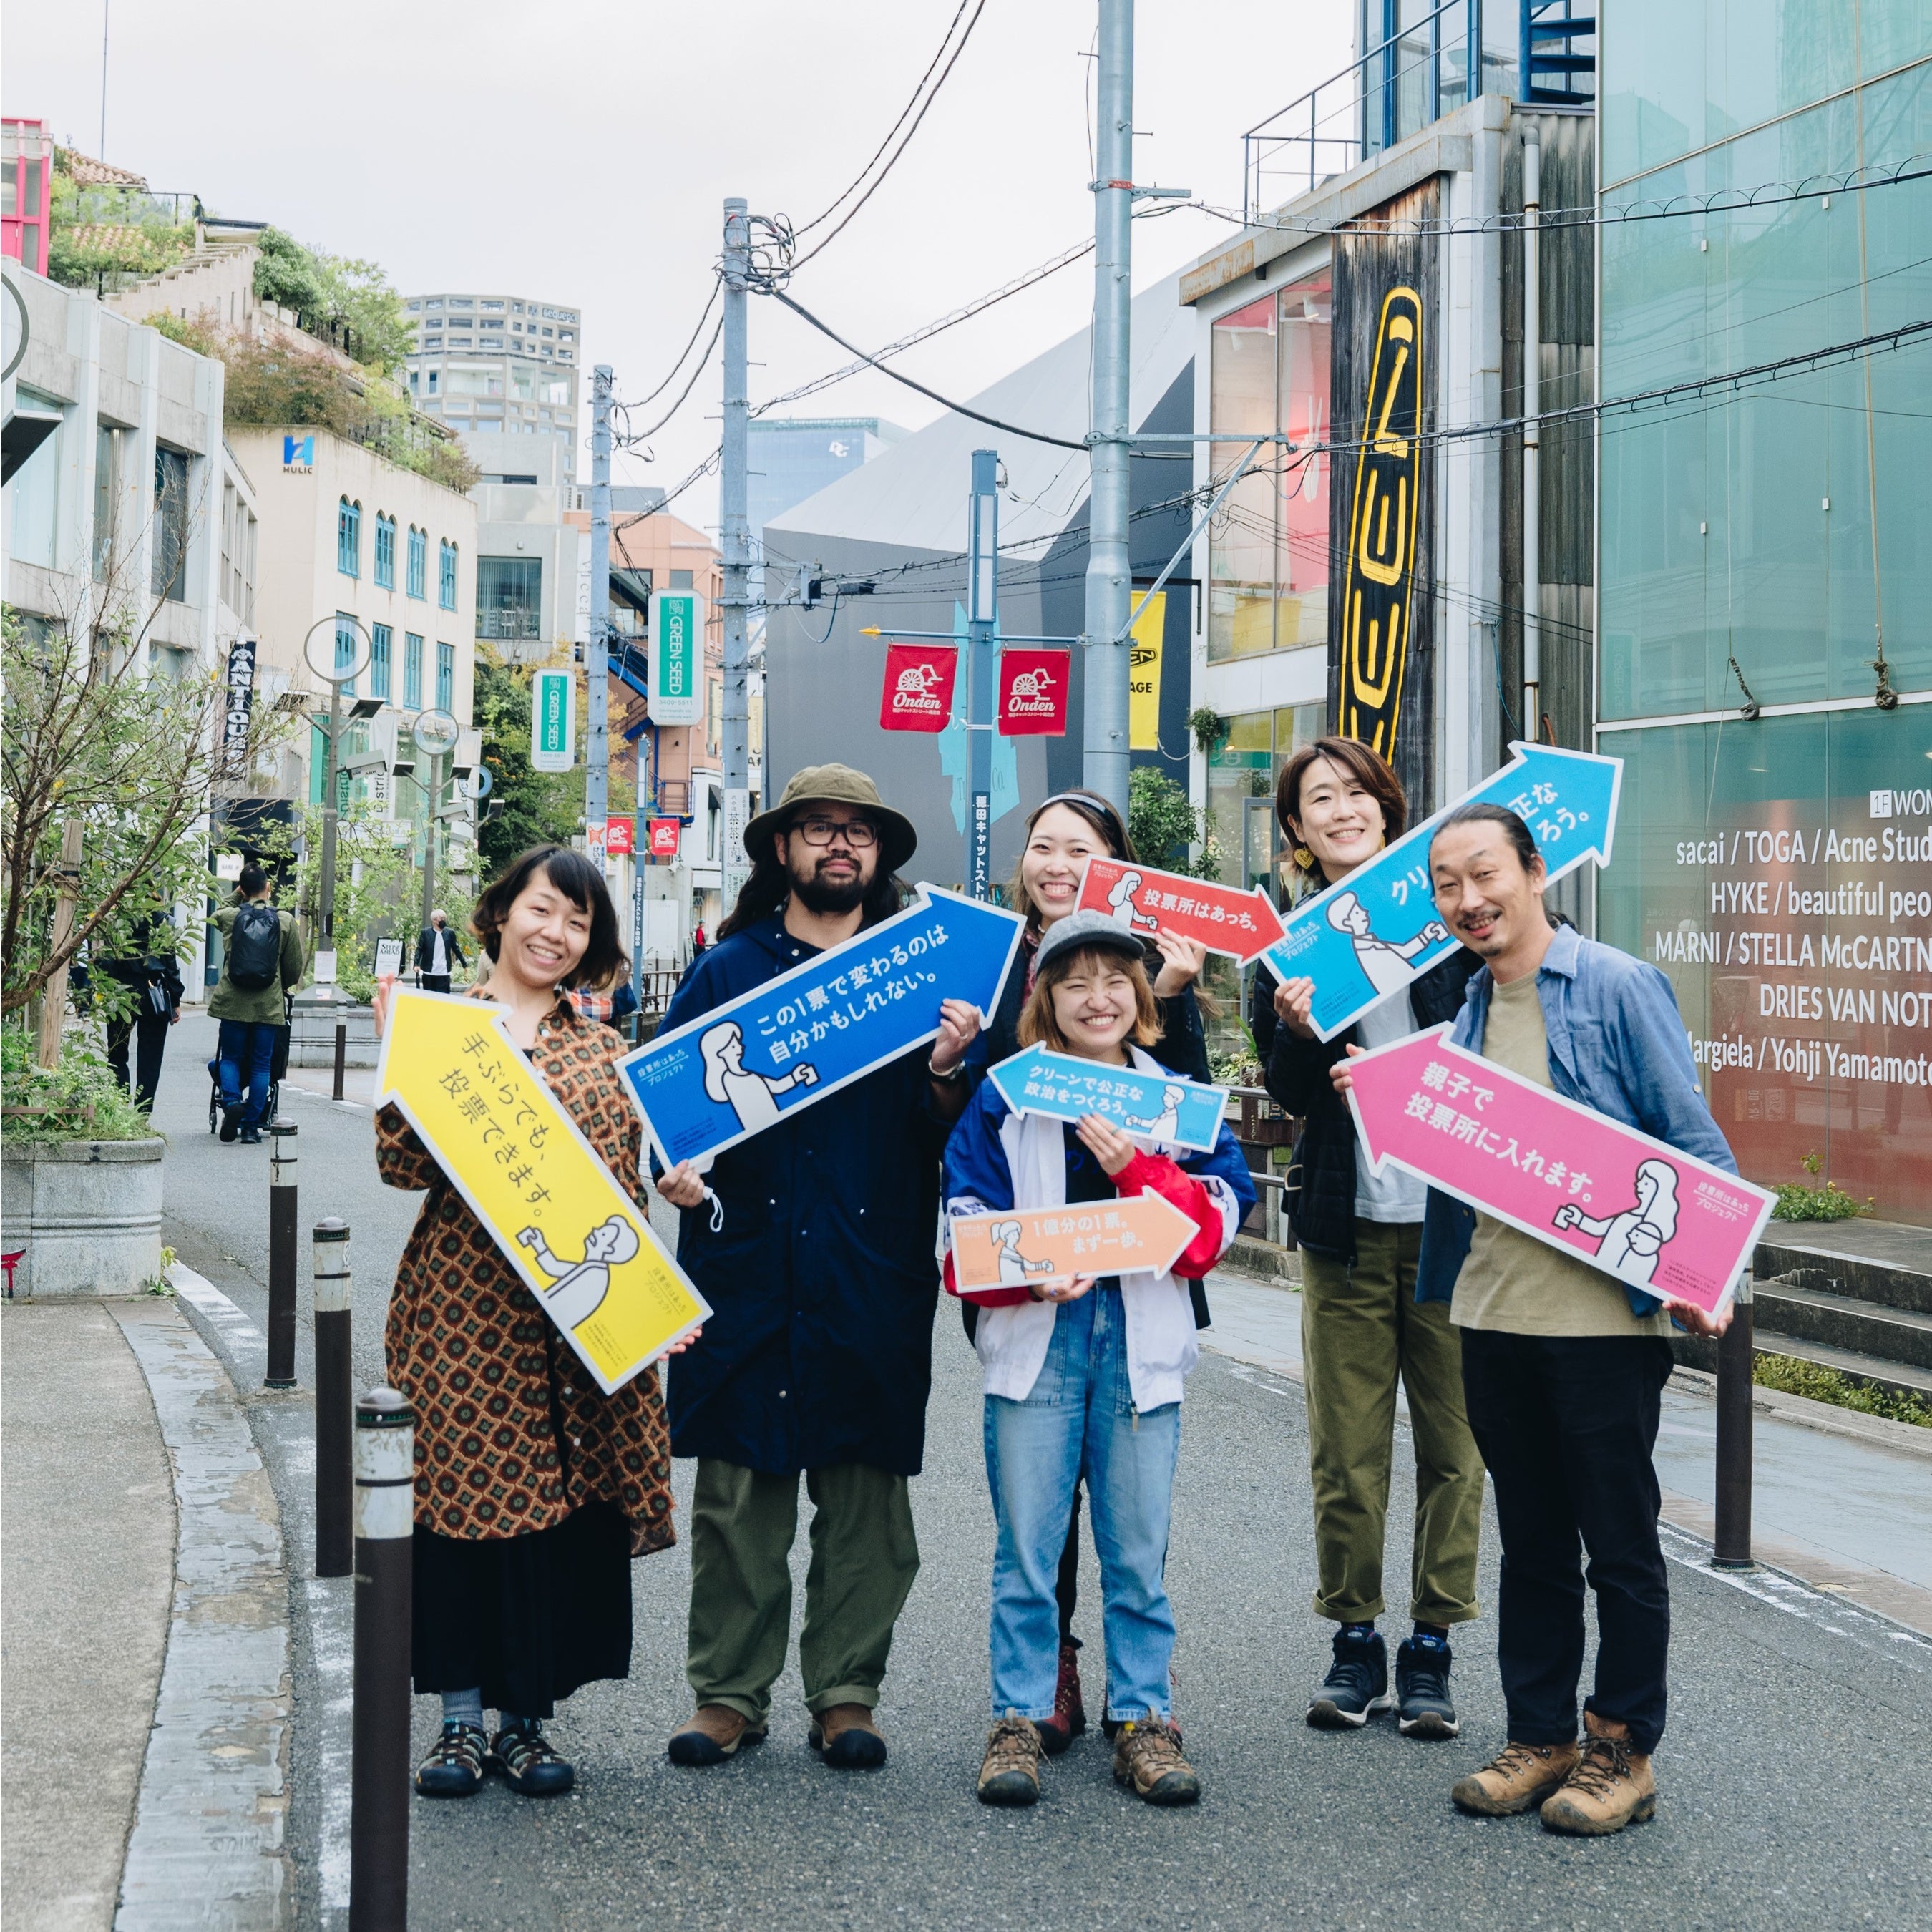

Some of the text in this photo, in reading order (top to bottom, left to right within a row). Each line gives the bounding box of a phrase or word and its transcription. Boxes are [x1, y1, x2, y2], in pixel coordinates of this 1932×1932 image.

[670, 615, 683, 659] GREEN
[1130, 650, 1155, 665] EN
[669, 660, 683, 695] SEED
[1130, 682, 1153, 693] AGE
[548, 690, 560, 723] GREEN
[893, 691, 942, 709] Onden
[1008, 696, 1056, 712] Onden
[548, 723, 559, 750] SEED
[1874, 794, 1889, 814] 1F
[1677, 831, 1724, 865] sacai
[1745, 830, 1806, 864] TOGA
[1824, 829, 1878, 862] Acne
[1881, 826, 1932, 862] Stud
[1143, 887, 1257, 933] 投票所はあっち。
[1712, 882, 1769, 914] HYKE
[1788, 881, 1883, 916] beautiful
[1890, 891, 1932, 924] peo
[1655, 930, 1720, 964] MARNI
[1738, 932, 1815, 967] STELLA
[757, 924, 950, 1036] この1票で変わるのは
[768, 970, 937, 1065] 自分かもしれない。
[1760, 983, 1932, 1028] DRIES VAN NOT
[648, 1063, 685, 1086] プロジェクト
[1689, 1031, 1753, 1072] argiela
[1770, 1038, 1820, 1082] Yohji
[461, 1031, 550, 1161] 手ぶらでも、
[1024, 1080, 1128, 1117] 政治をつくろう。
[1029, 1065, 1143, 1102] クリーンで公正な
[1420, 1060, 1496, 1111] 親子で
[439, 1068, 552, 1218] 投票できます。
[1404, 1091, 1594, 1204] 投票所に入れます。
[1033, 1211, 1128, 1237] 1億分の1票。
[1695, 1196, 1739, 1224] プロジェクト
[1073, 1231, 1144, 1254] まず一歩。
